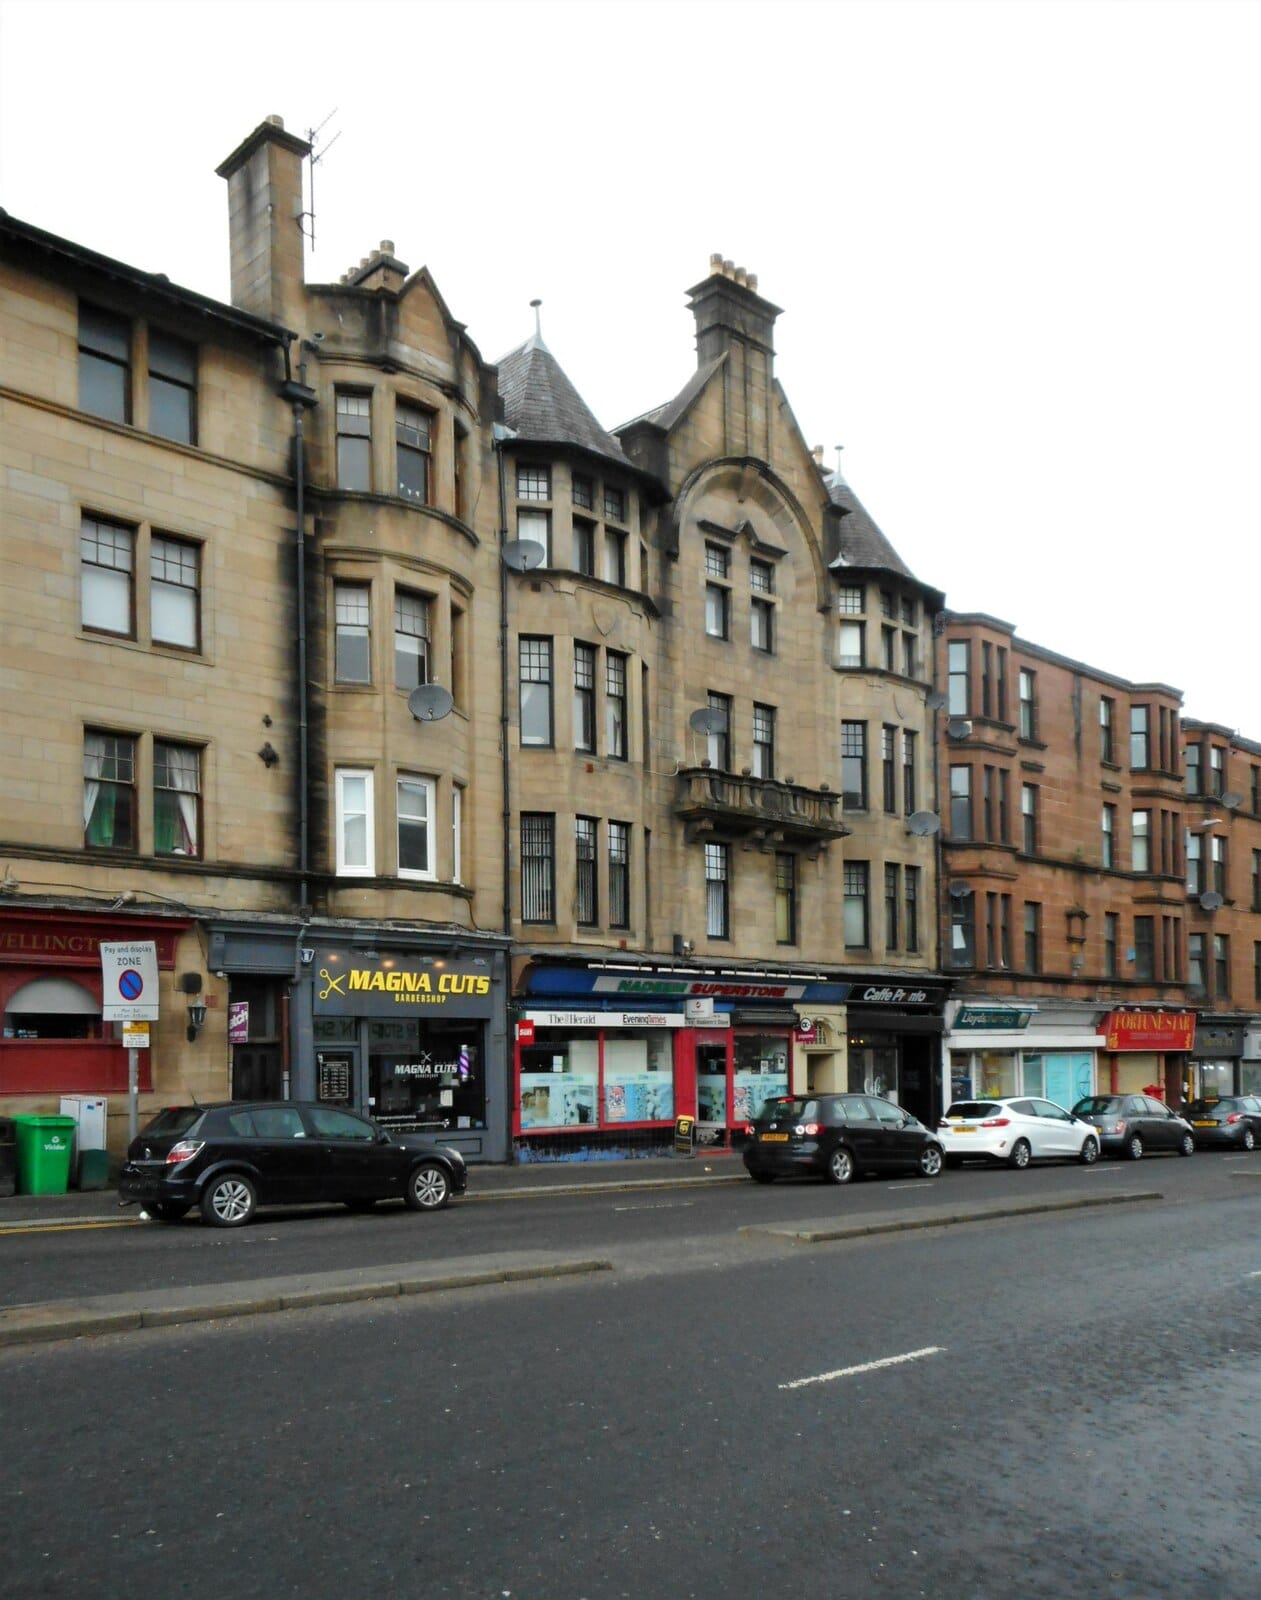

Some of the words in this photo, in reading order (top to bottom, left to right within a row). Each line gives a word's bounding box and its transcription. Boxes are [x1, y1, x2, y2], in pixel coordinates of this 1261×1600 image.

[104, 946, 116, 954] Pay
[130, 945, 152, 954] display
[117, 957, 142, 966] ZONE
[348, 969, 432, 993] MAGNA
[438, 973, 490, 994] CUTS
[690, 983, 788, 998] SUPERSTORE
[863, 987, 892, 1001] Caffe
[394, 993, 447, 1004] BARBERSHOP
[548, 1014, 564, 1024] The
[569, 1014, 596, 1025] Herald
[1115, 1013, 1162, 1031] FORTUNE
[1166, 1015, 1190, 1031] STAR
[394, 1063, 432, 1075] MAGNA
[433, 1063, 458, 1074] CUTS
